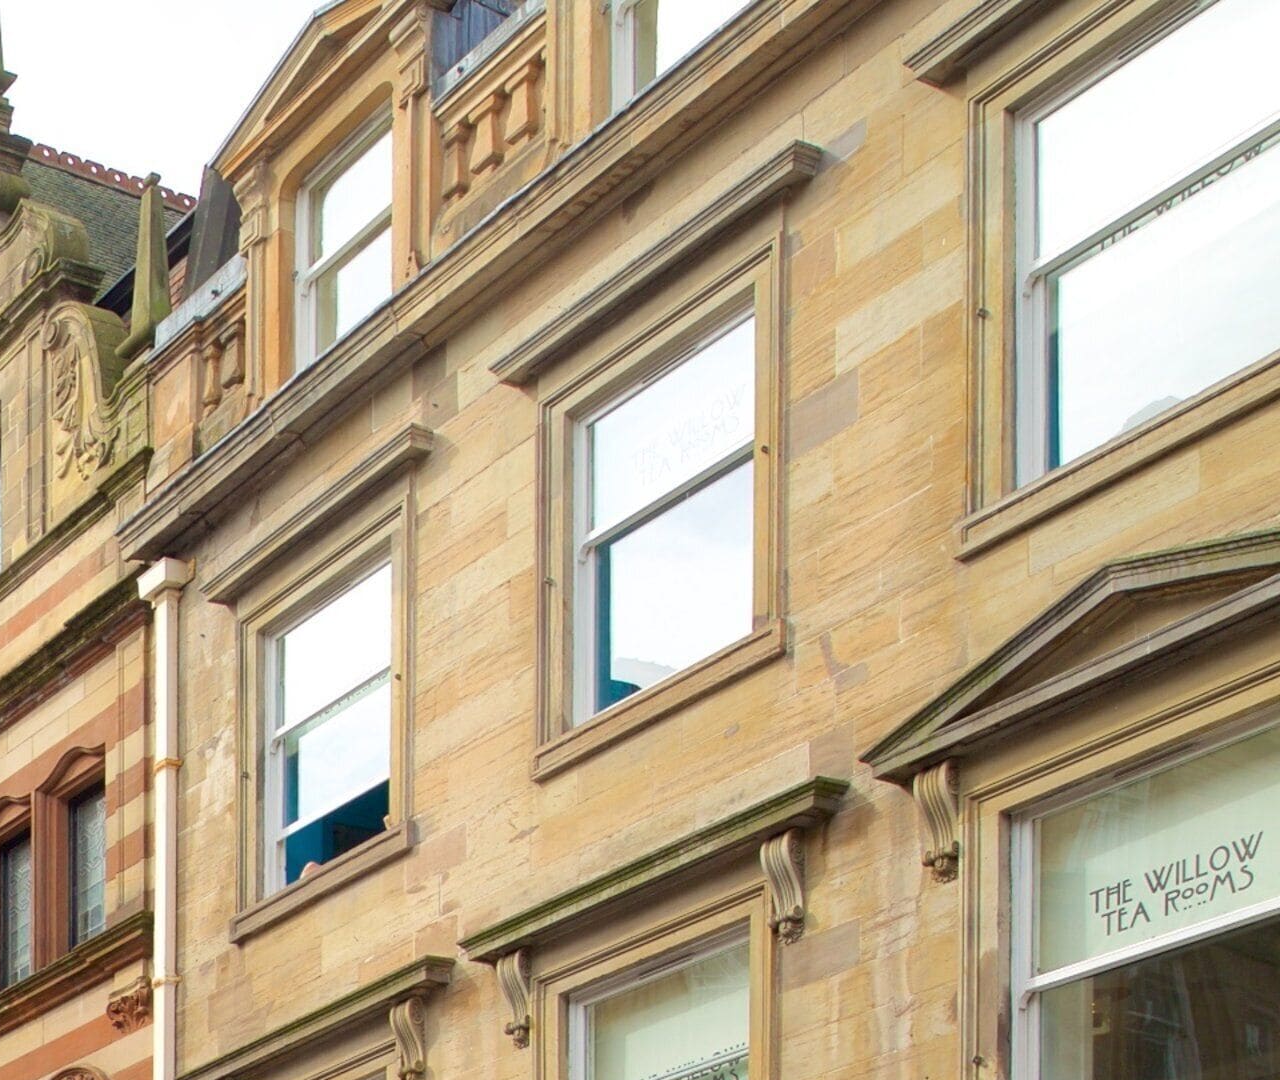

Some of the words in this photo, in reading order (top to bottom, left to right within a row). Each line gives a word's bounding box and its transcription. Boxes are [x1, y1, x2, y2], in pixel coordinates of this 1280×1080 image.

[1089, 878, 1133, 913] THE
[1144, 830, 1263, 894] WILLOW
[1101, 901, 1151, 936] TEA
[1164, 864, 1254, 916] ROOMS
